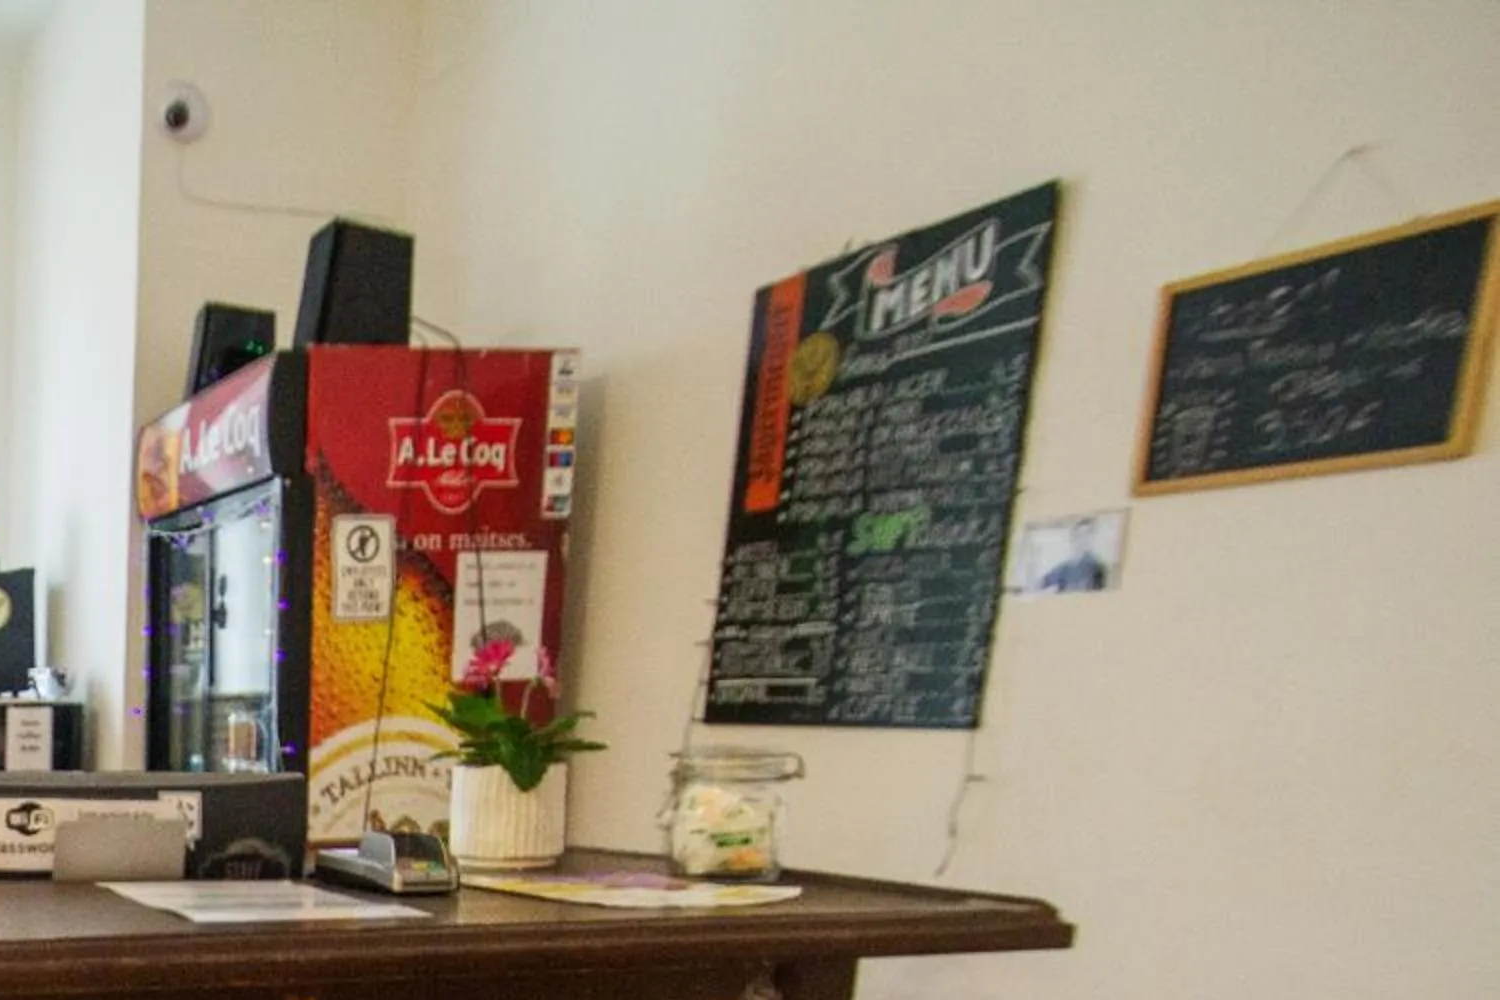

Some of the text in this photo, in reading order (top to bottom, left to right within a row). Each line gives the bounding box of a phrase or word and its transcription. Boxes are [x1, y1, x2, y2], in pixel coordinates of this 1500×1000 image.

[869, 224, 996, 332] MENU
[413, 532, 442, 550] on
[320, 755, 426, 804] TALLINN
